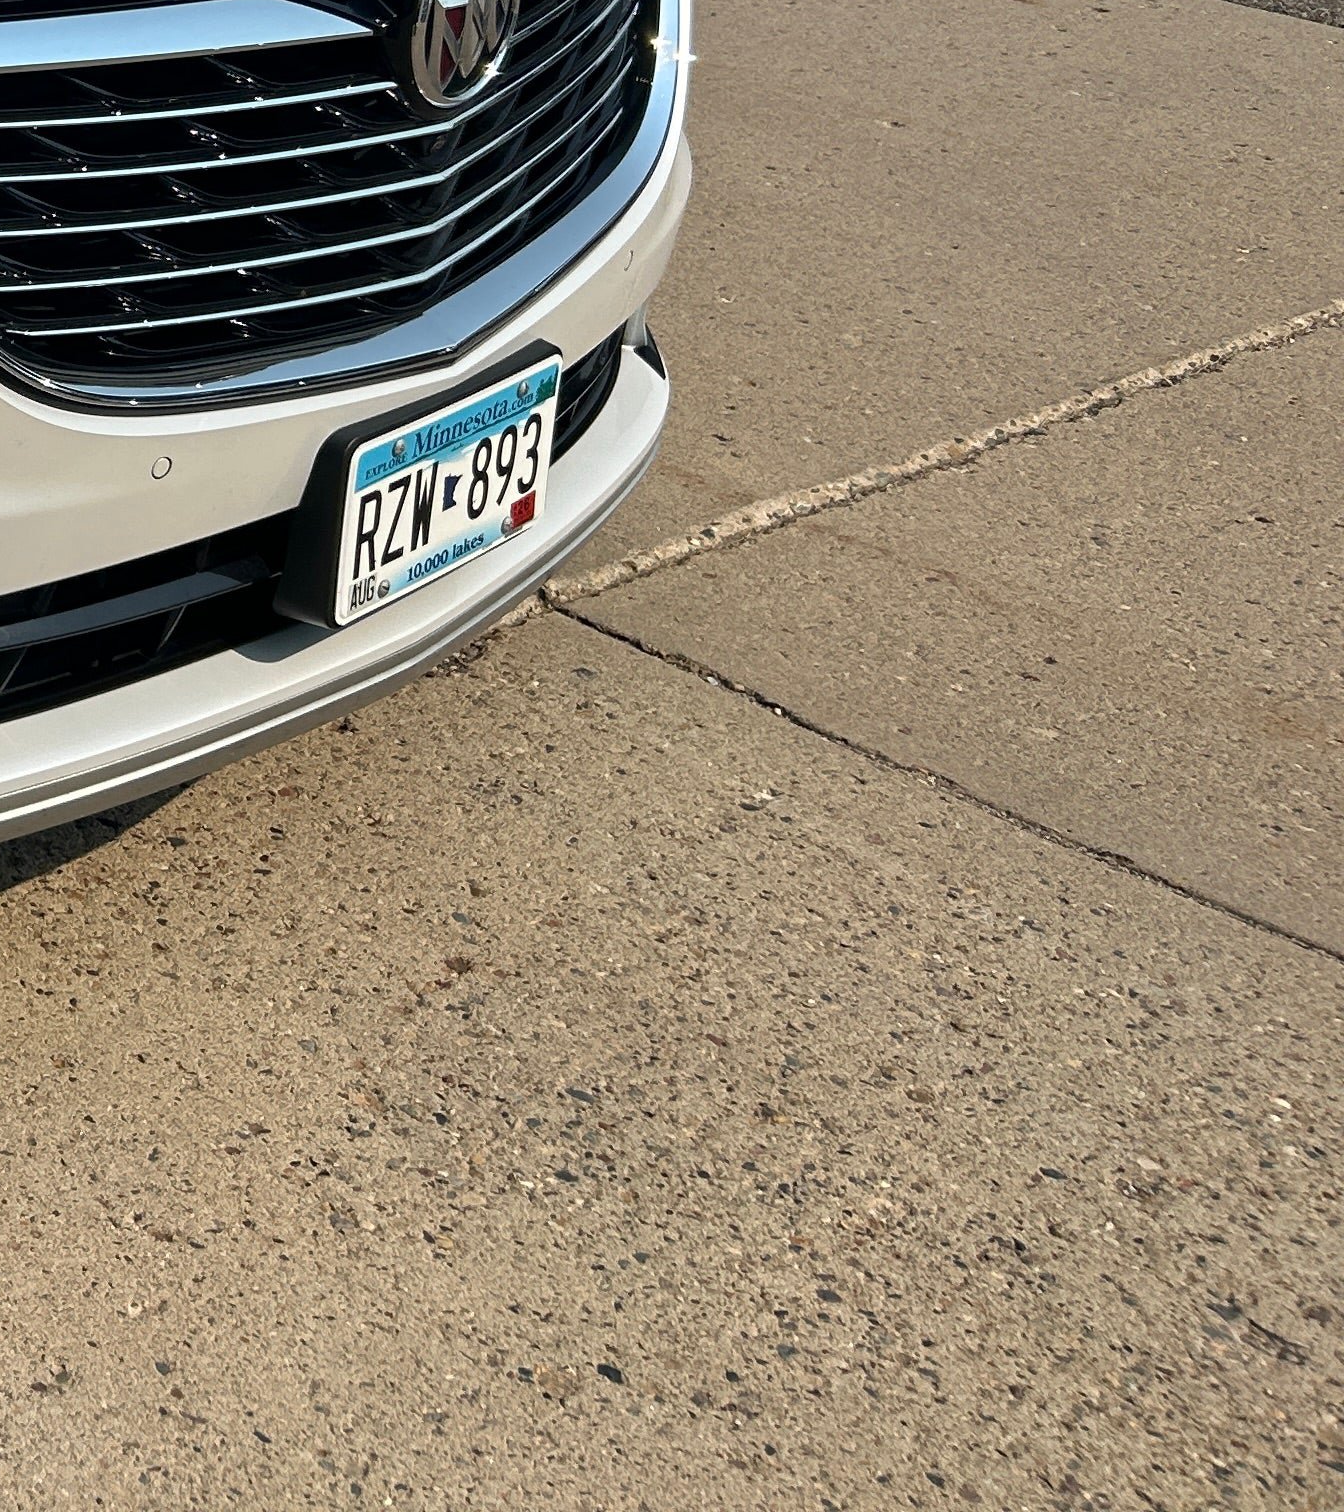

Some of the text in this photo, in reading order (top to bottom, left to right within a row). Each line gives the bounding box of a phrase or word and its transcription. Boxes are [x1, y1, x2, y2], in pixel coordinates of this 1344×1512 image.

[365, 451, 409, 480] EXPLORE
[353, 412, 542, 580] RZW 893
[407, 533, 485, 583] 10,000 lakes
[350, 575, 376, 611] AUG
